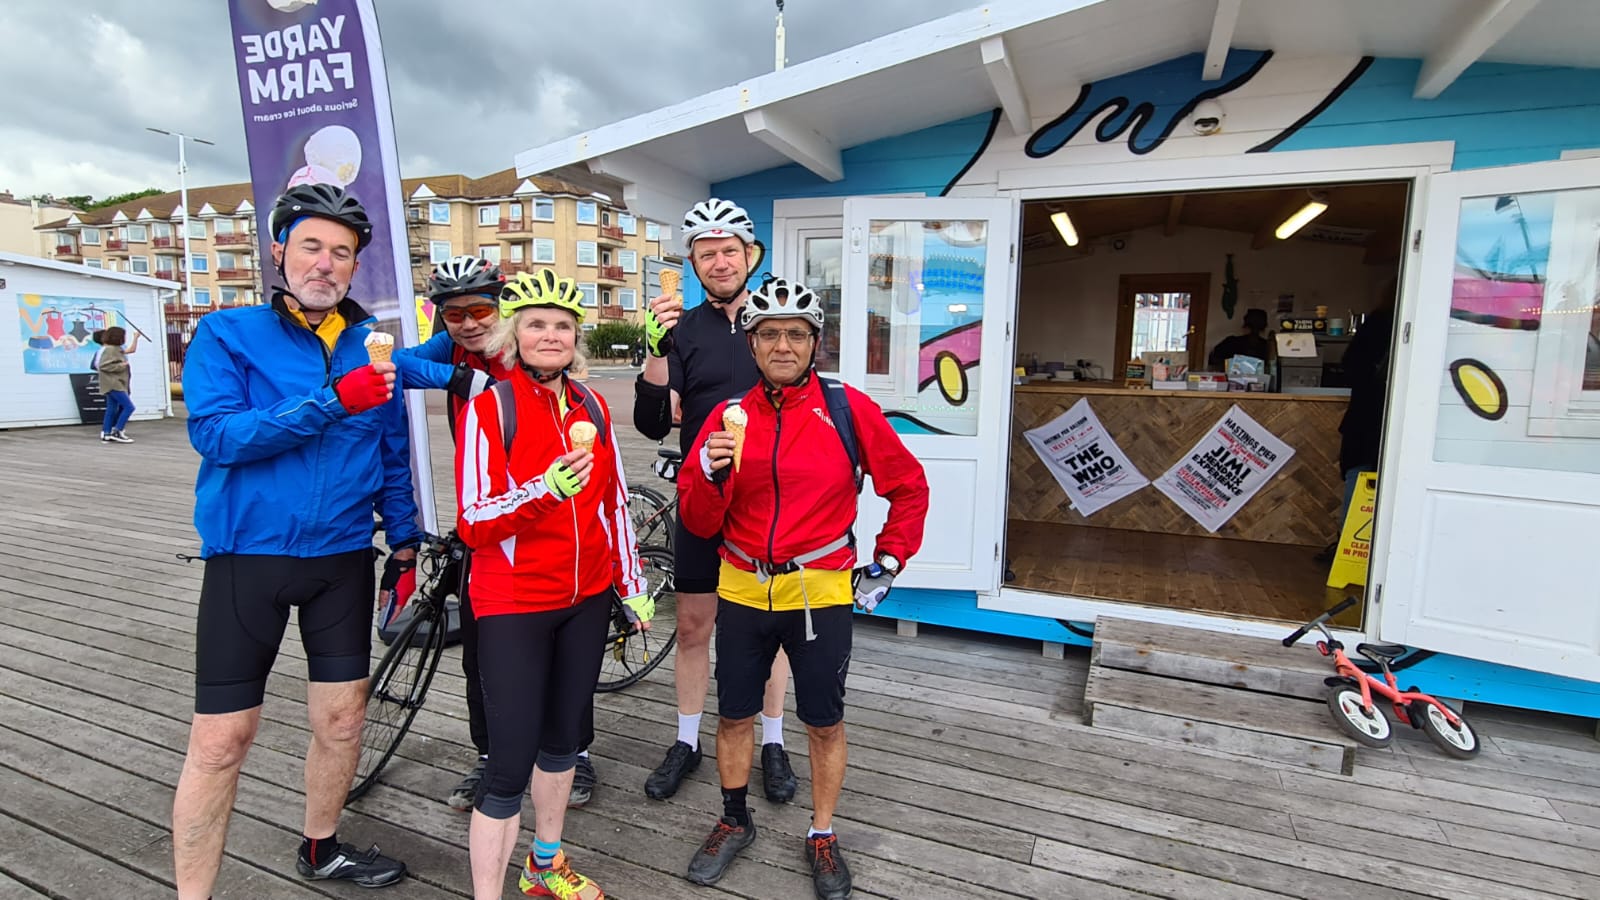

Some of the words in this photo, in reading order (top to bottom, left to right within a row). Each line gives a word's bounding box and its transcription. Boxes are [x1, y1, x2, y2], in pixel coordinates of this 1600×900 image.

[1064, 442, 1104, 470] THE
[1225, 417, 1260, 449] HASTINGS
[1257, 445, 1278, 463] PIER
[1072, 456, 1115, 484] WHO
[1191, 453, 1243, 497] EXPERIENCE
[1202, 452, 1243, 487] HENDRIX
[1211, 446, 1252, 480] JIMI
